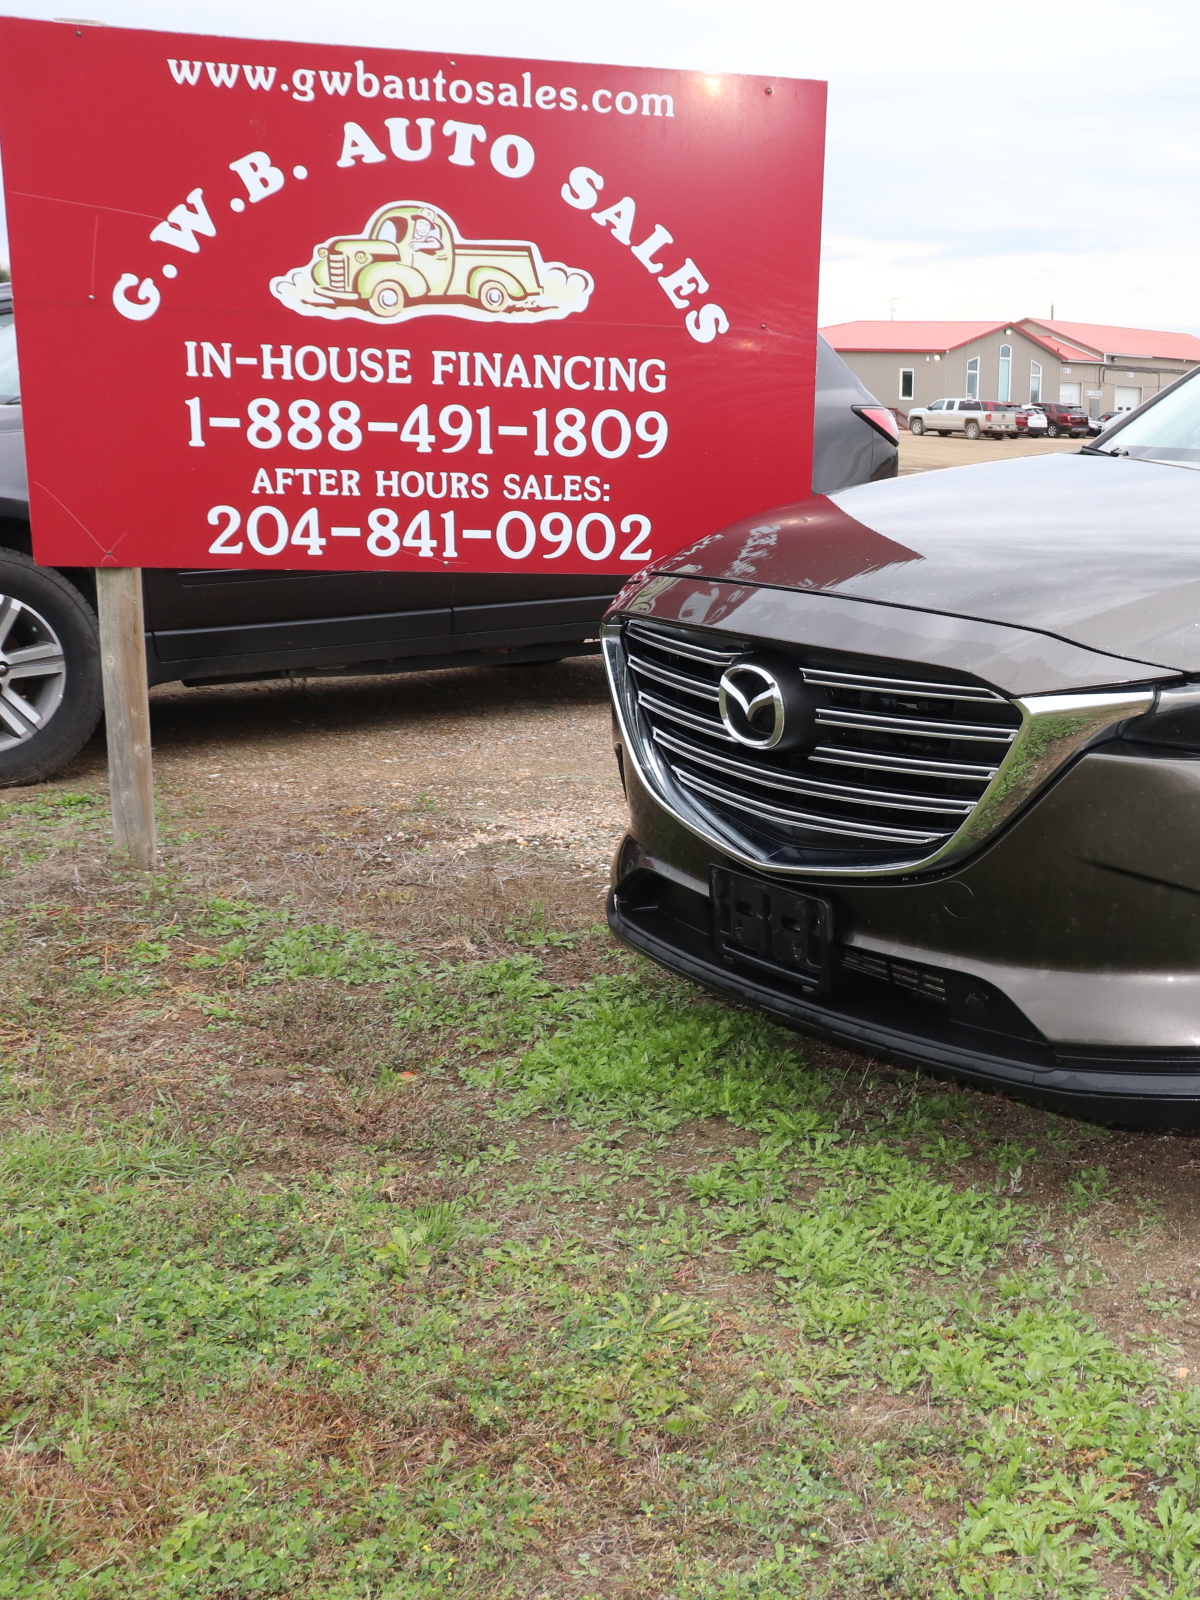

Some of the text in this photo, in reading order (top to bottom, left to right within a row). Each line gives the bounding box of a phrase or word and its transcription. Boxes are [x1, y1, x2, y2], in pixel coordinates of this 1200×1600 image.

[166, 58, 676, 118] www.gwbautosales.com
[336, 116, 536, 179] AUTO
[560, 165, 730, 344] SALES
[184, 340, 668, 394] IN-HOUSE FINANCING
[184, 396, 669, 459] 1-888-491-1809
[251, 467, 611, 503] AFTER HOURS SALES:
[206, 504, 653, 561] 204-841-0902
